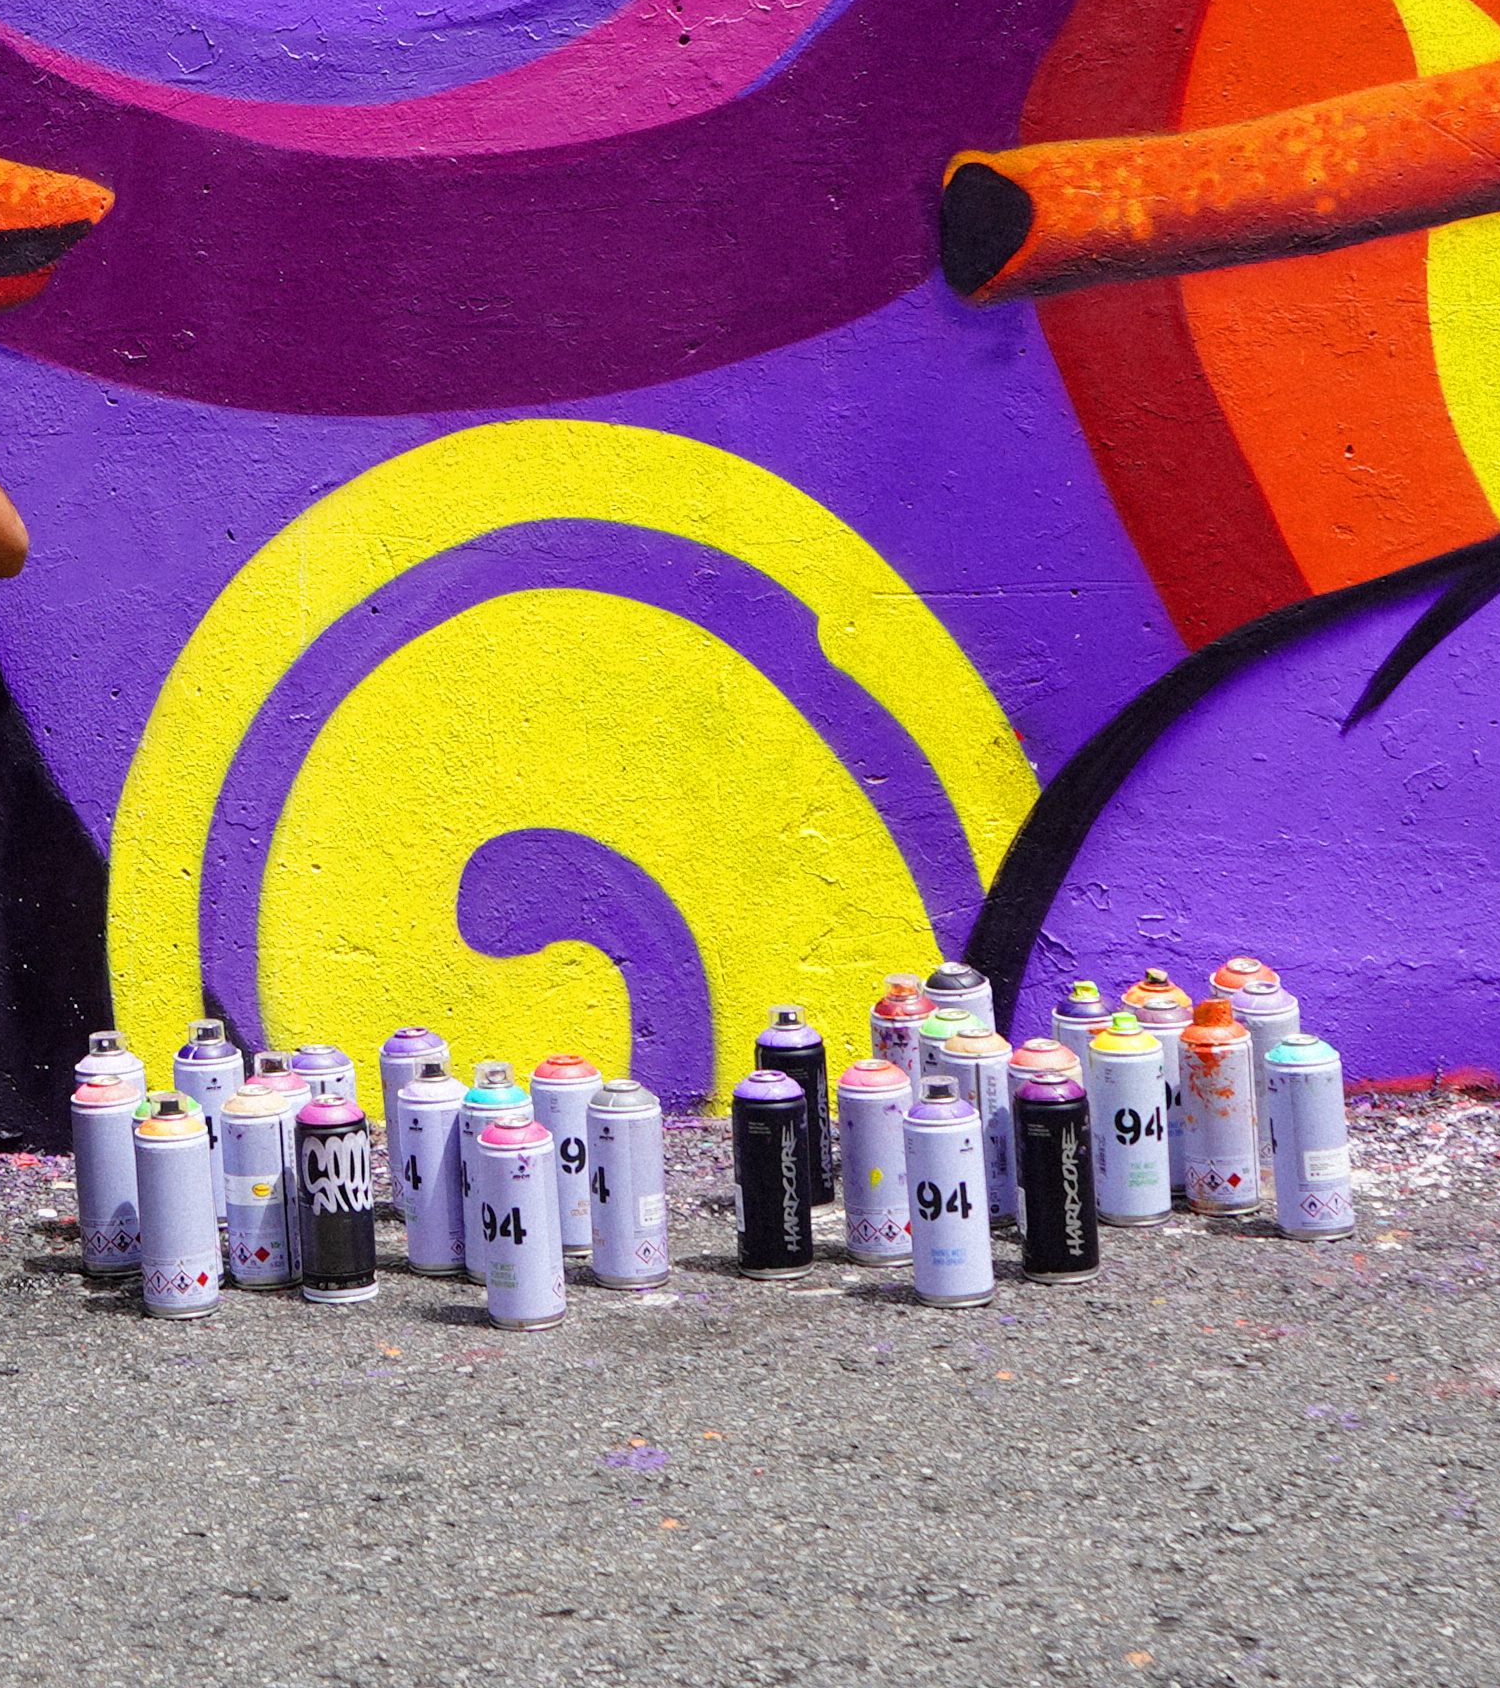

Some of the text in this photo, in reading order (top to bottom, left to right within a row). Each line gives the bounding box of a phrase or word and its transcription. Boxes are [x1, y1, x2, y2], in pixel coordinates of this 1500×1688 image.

[1114, 1106, 1164, 1146] 94
[780, 1120, 803, 1253] HARDCORE
[916, 1180, 972, 1222] 94
[1061, 1121, 1086, 1257] HARDCORE
[481, 1201, 528, 1245] 94
